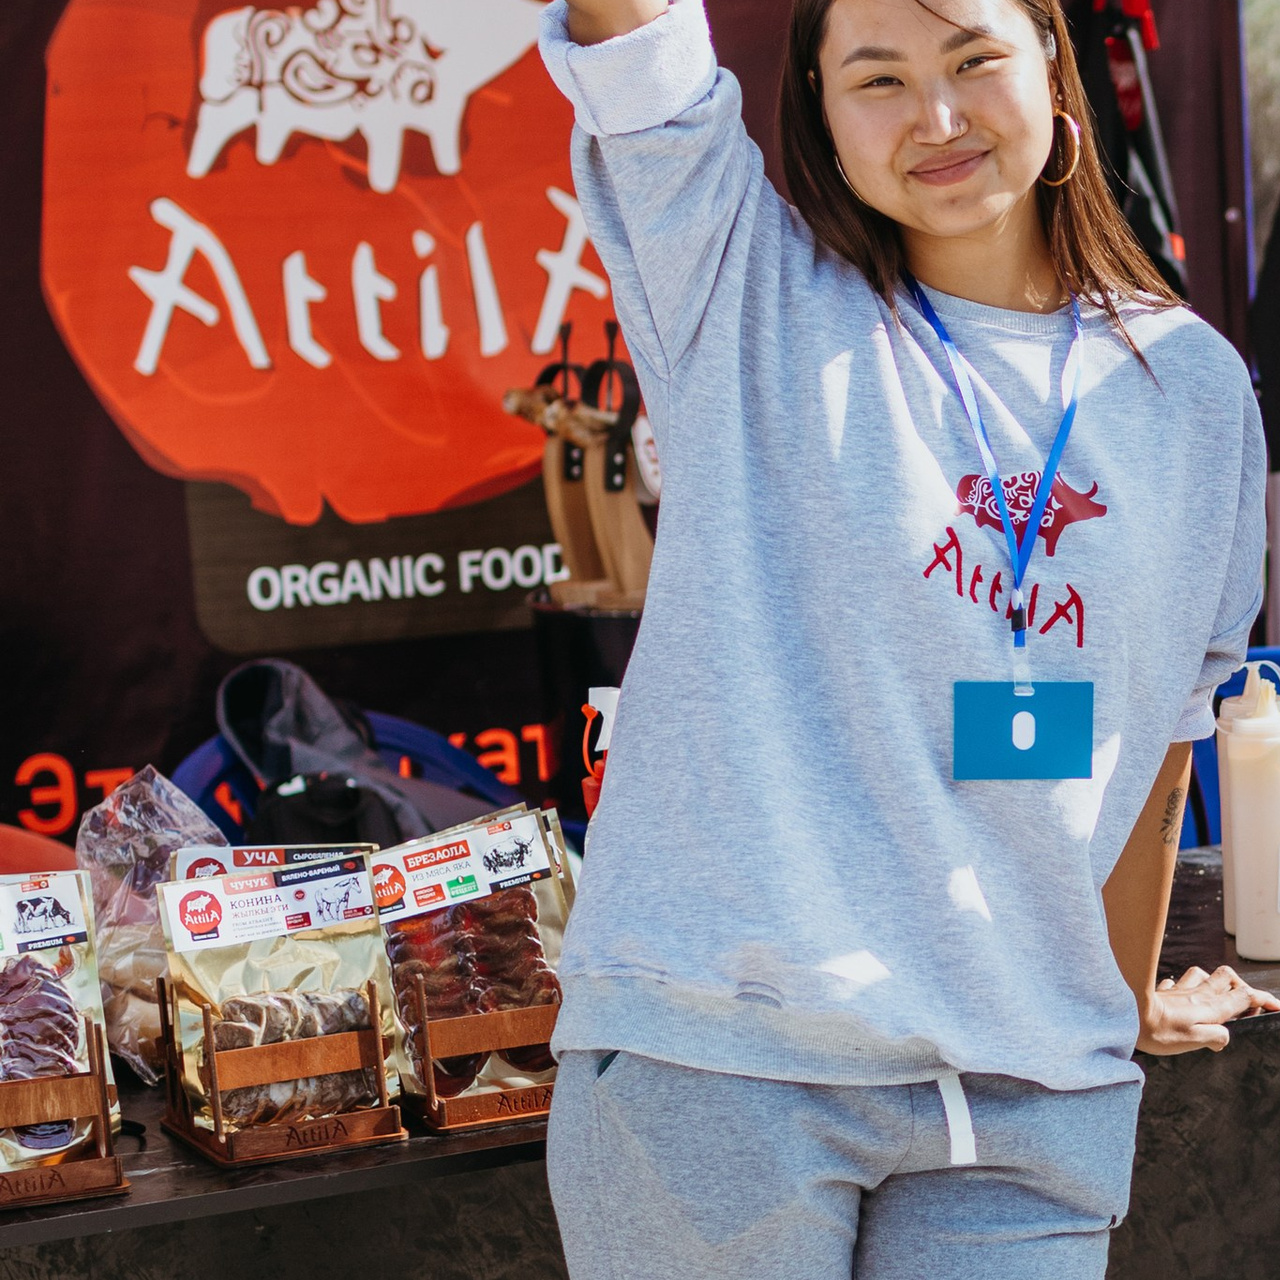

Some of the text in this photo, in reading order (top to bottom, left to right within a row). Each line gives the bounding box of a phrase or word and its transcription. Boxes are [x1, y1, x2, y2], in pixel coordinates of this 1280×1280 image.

[128, 185, 608, 375] AttilA
[247, 552, 447, 612] ORGANIC
[243, 851, 280, 865] УЧА
[407, 843, 468, 869] БРЕЗАОЛА
[453, 860, 472, 870] ЯКА
[229, 876, 269, 891] ЧУЧУК
[375, 881, 405, 899] ttilA
[499, 874, 531, 889] PREMIUM
[229, 893, 283, 910] КОНИНА
[184, 909, 221, 926] AttilA
[28, 937, 64, 950] PREMIUM
[285, 1118, 349, 1147] AttilA
